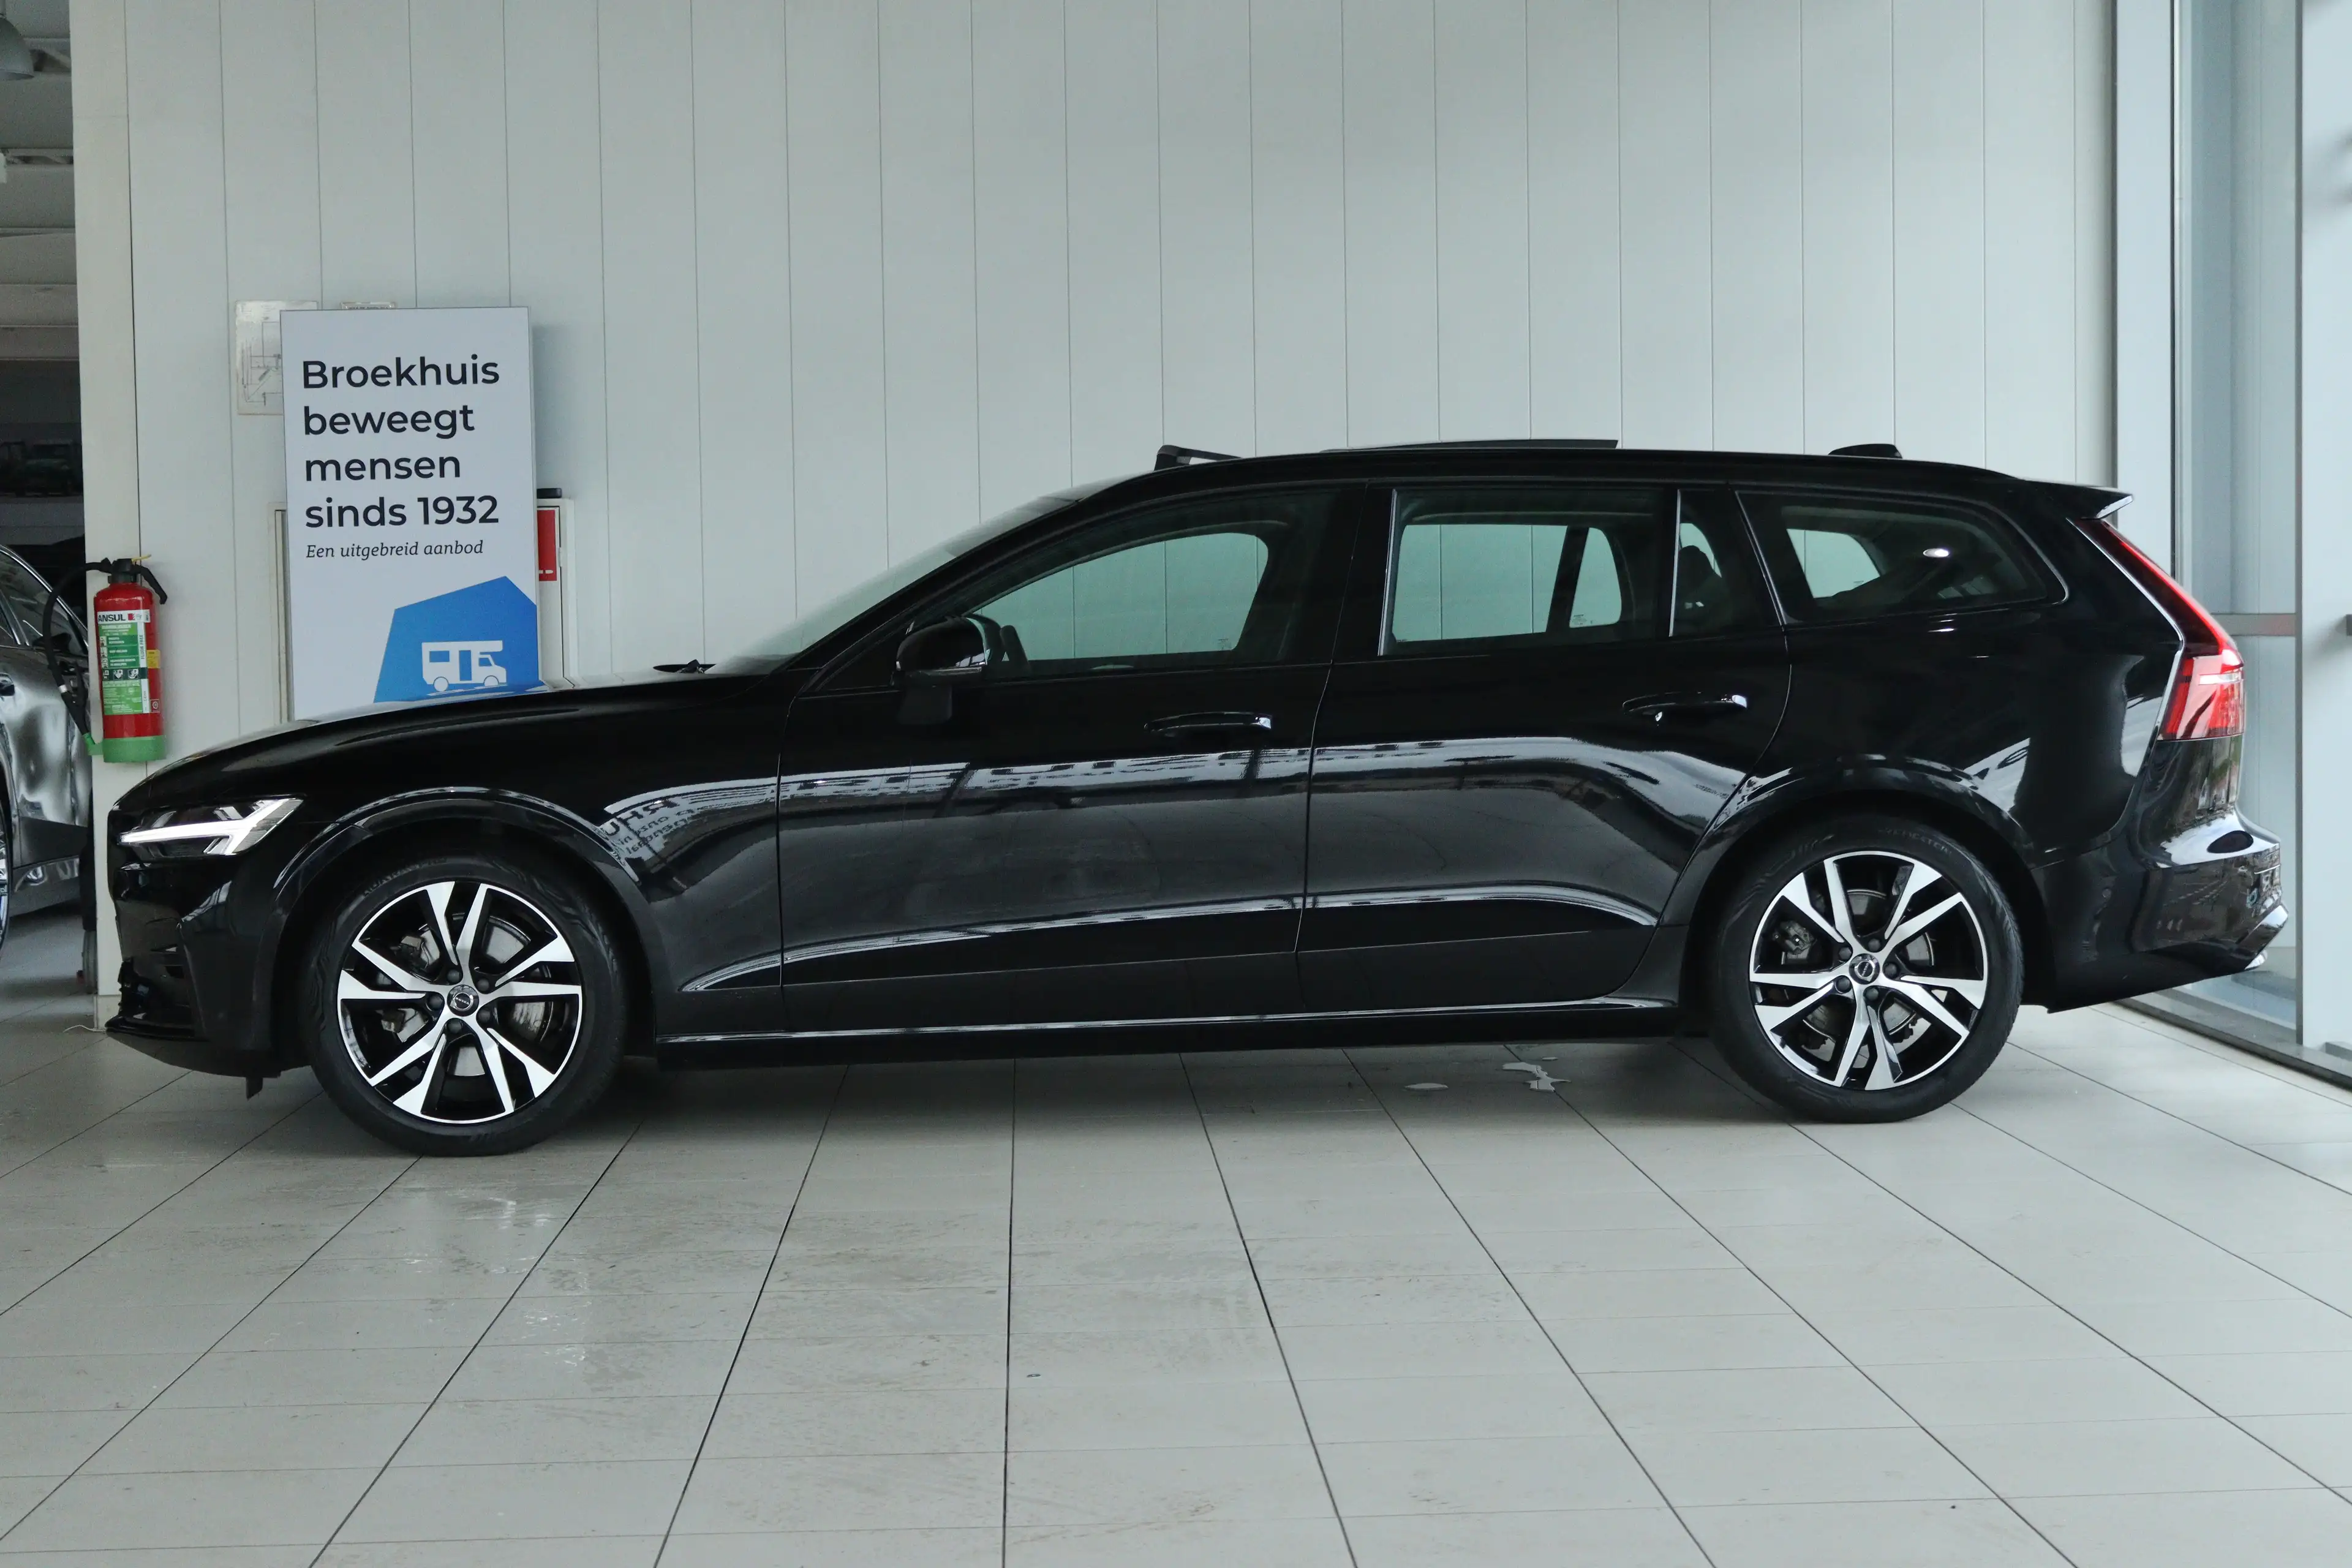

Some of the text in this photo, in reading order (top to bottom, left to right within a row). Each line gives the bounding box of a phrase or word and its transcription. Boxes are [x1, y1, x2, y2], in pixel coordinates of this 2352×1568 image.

[303, 353, 500, 389] Broekhuis
[304, 405, 475, 439] beweegt
[305, 456, 461, 481] mensen
[305, 495, 499, 528] sinds 1932
[306, 540, 484, 561] Een uitgebreid aanbod
[97, 614, 126, 622] ANSUL
[455, 997, 470, 1005] VOLVO
